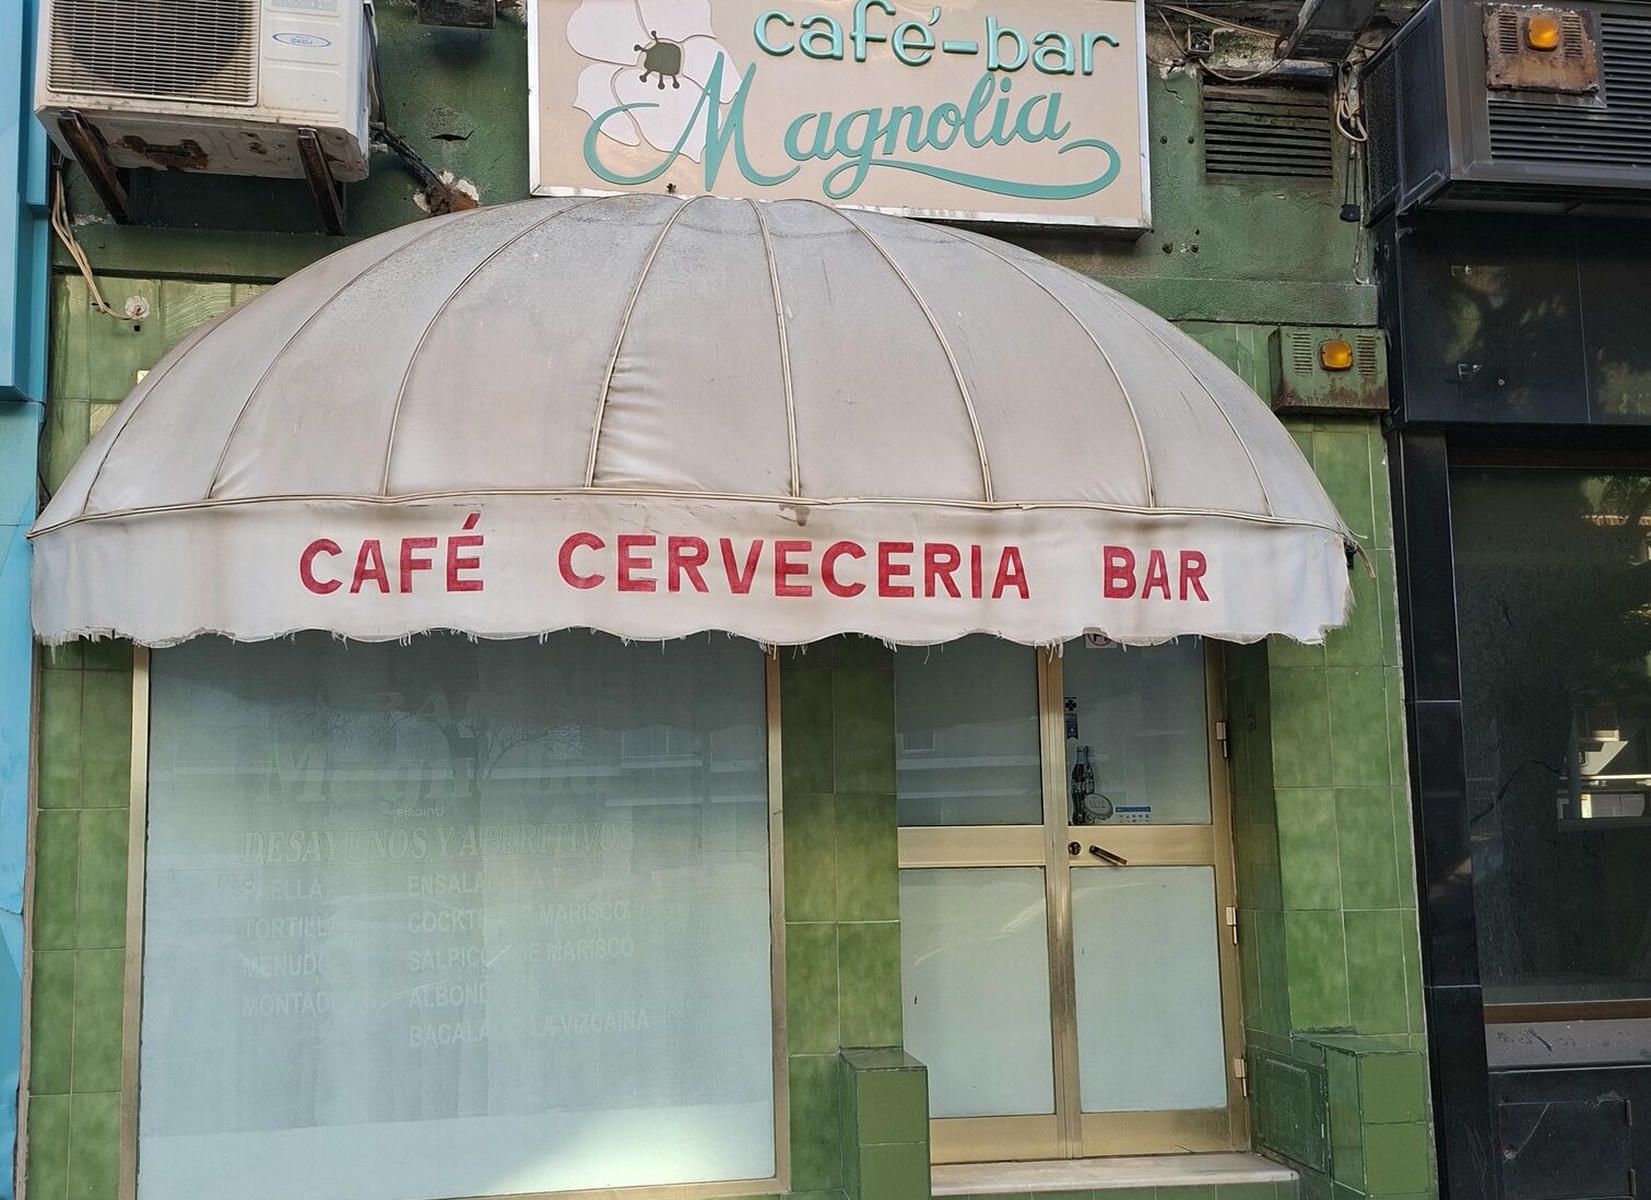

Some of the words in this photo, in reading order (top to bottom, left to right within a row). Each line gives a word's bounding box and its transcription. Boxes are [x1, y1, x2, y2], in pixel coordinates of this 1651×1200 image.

[753, 0, 1120, 75] café-bar
[583, 50, 1121, 200] Magnolia
[299, 512, 485, 595] CAFÉ
[557, 531, 1031, 600] CERVECERIA
[1102, 545, 1210, 602] BAR
